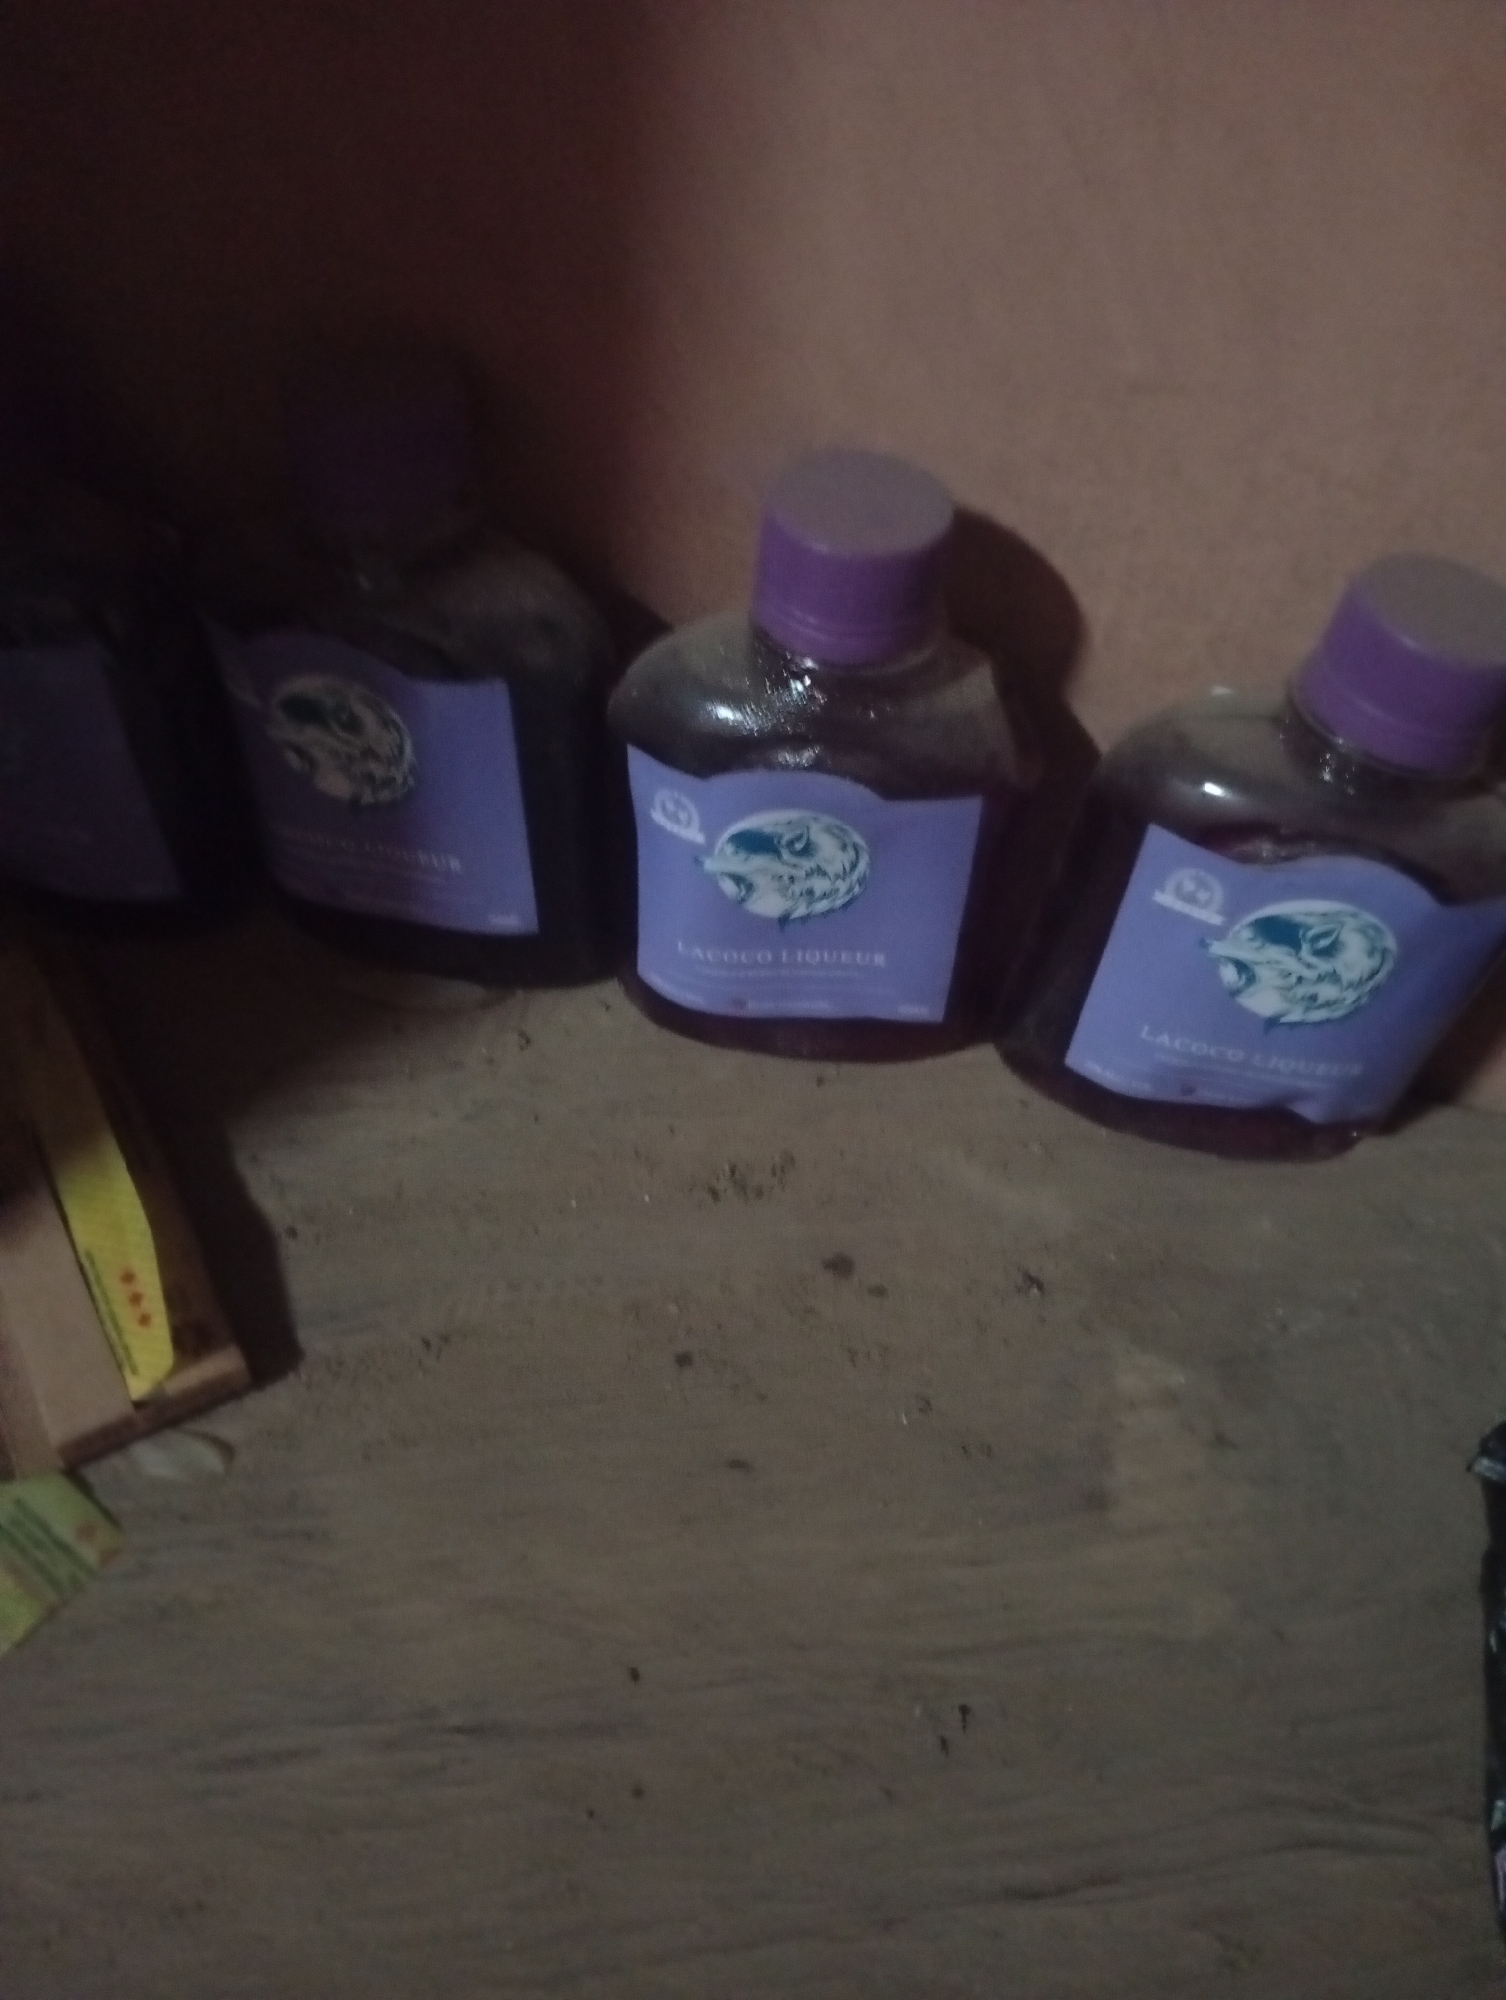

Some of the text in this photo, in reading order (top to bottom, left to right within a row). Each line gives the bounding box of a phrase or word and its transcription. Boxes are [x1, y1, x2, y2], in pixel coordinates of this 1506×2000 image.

[678, 940, 886, 967] LACOCO LIQUEUR
[1140, 1025, 1246, 1062] LACOCO
